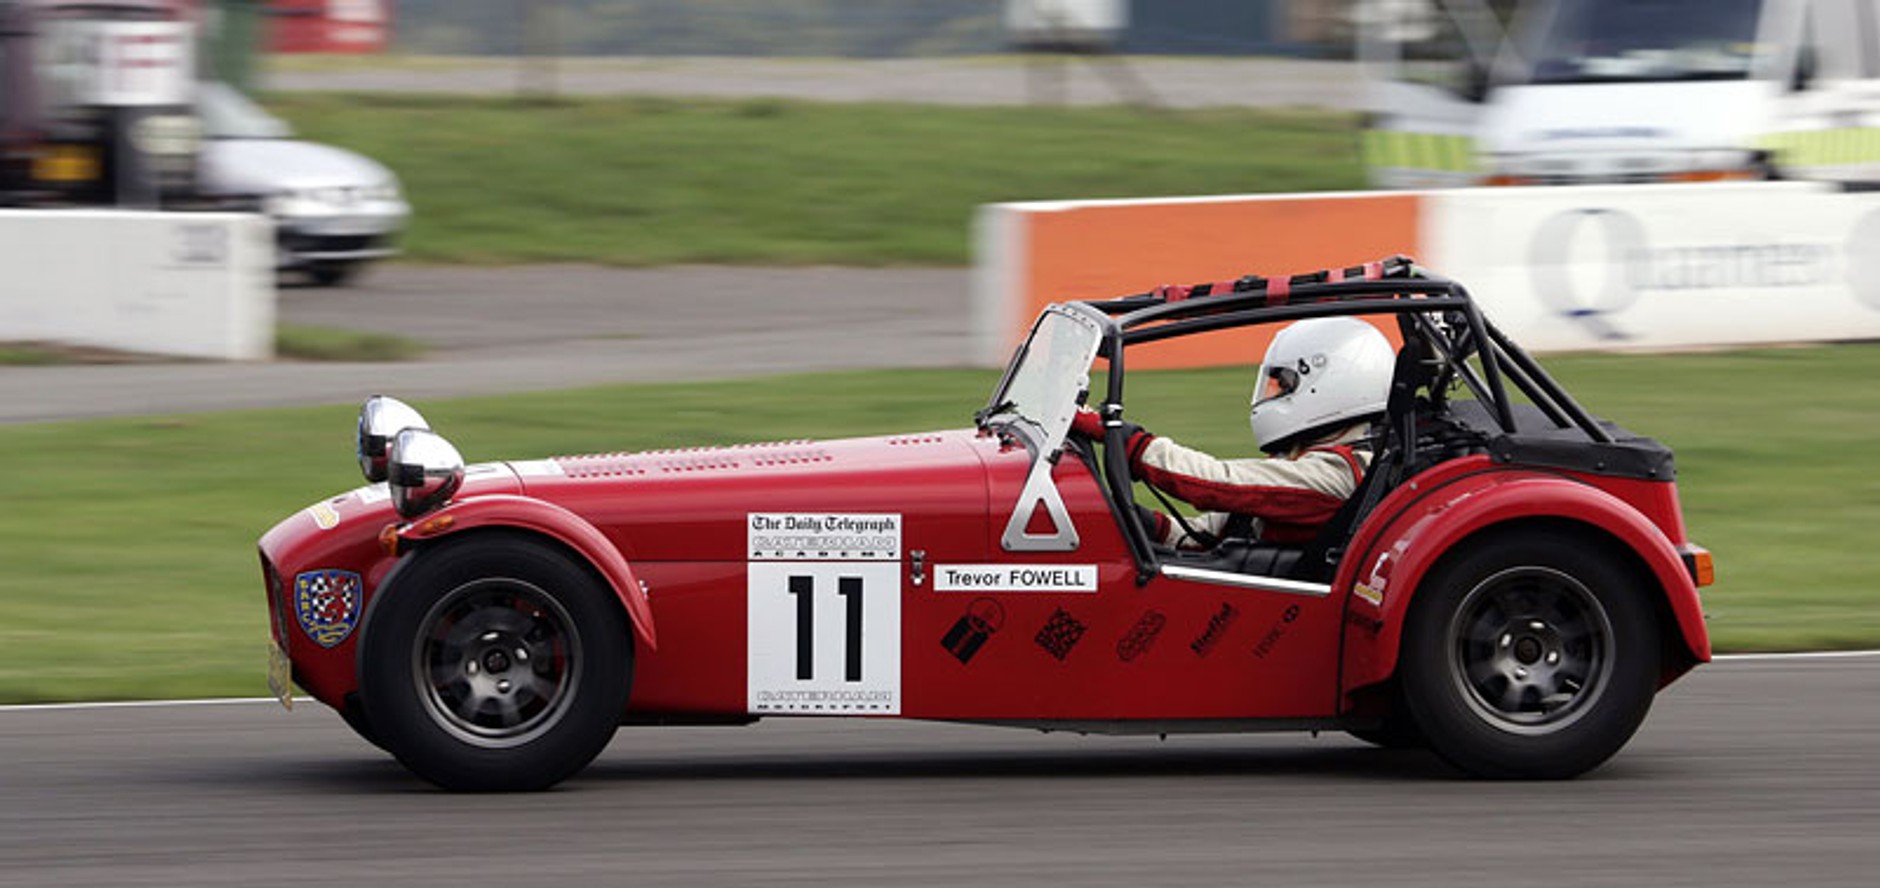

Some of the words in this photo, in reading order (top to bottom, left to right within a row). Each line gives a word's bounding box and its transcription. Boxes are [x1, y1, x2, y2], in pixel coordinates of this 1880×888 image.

[752, 516, 781, 531] The
[784, 516, 822, 533] Daily
[825, 516, 896, 534] Telegraph
[946, 570, 1002, 586] Trevor
[1010, 570, 1085, 586] FOWELL
[788, 575, 863, 682] 11
